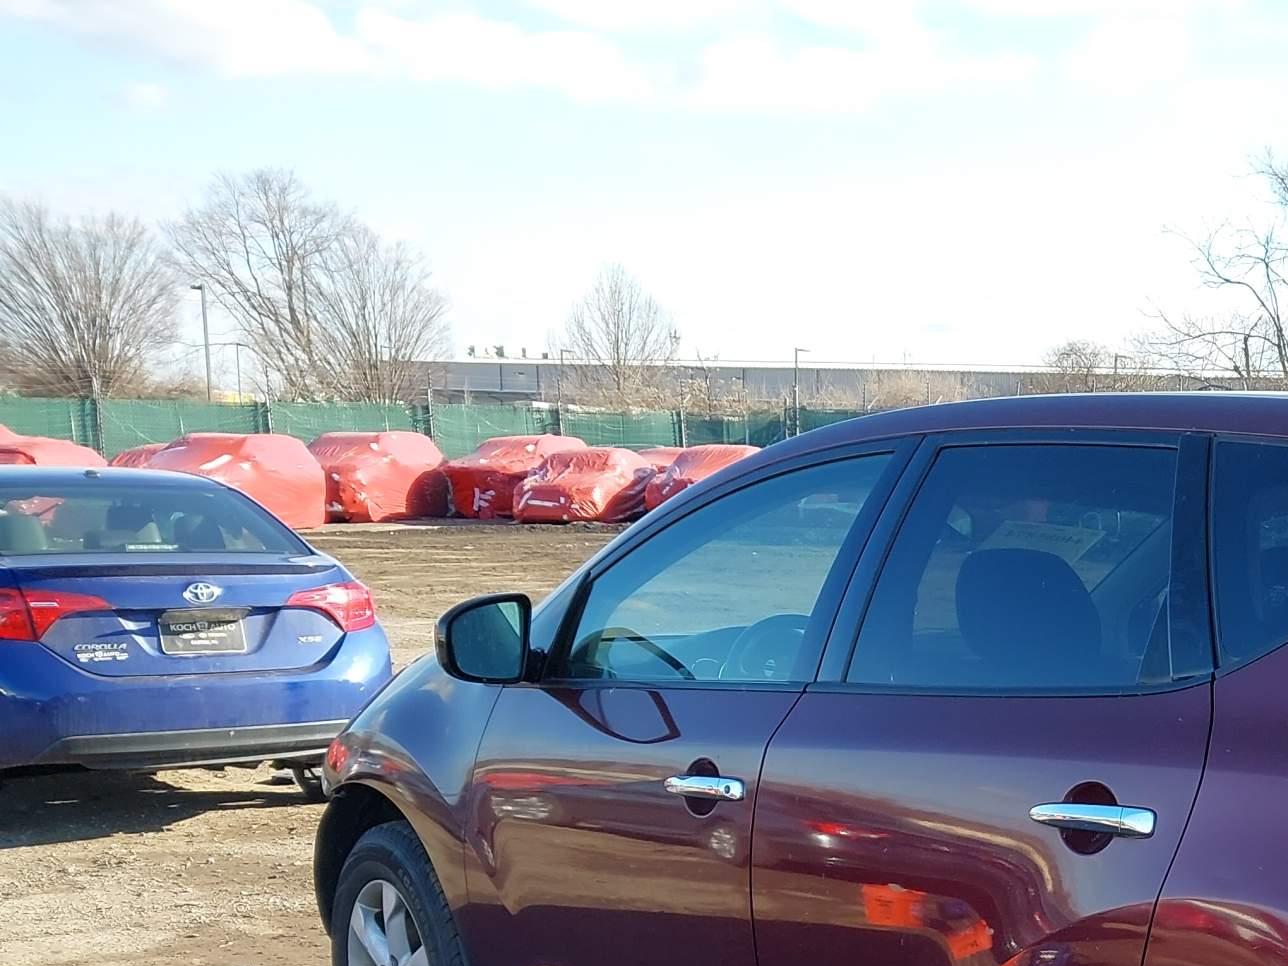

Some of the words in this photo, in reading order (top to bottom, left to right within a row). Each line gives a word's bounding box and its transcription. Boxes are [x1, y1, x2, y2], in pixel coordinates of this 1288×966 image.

[169, 623, 197, 632] KOCH
[209, 622, 236, 632] AUTO
[73, 643, 128, 651] COROLLA
